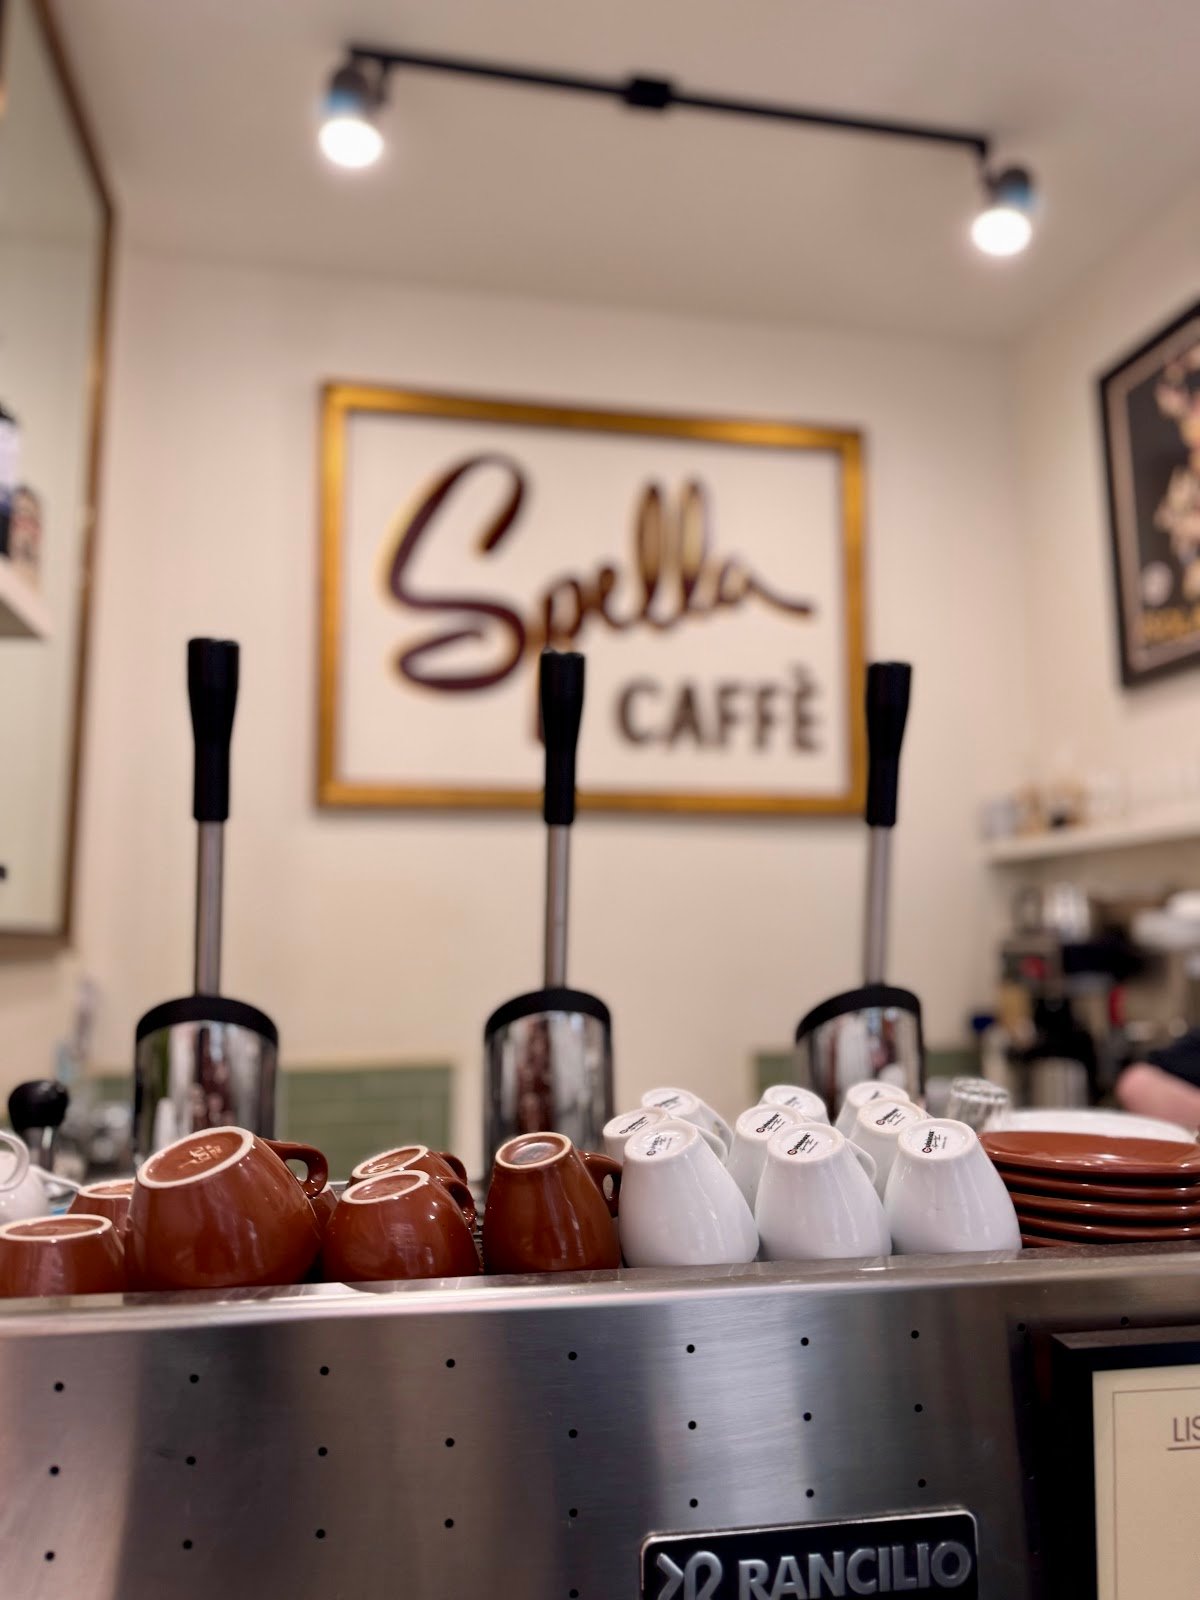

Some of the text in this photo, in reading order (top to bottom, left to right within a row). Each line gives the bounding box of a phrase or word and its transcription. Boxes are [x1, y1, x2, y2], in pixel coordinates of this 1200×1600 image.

[380, 451, 815, 745] Spella
[616, 664, 821, 751] CAFFÈ
[738, 1541, 972, 1600] RANCILIO
